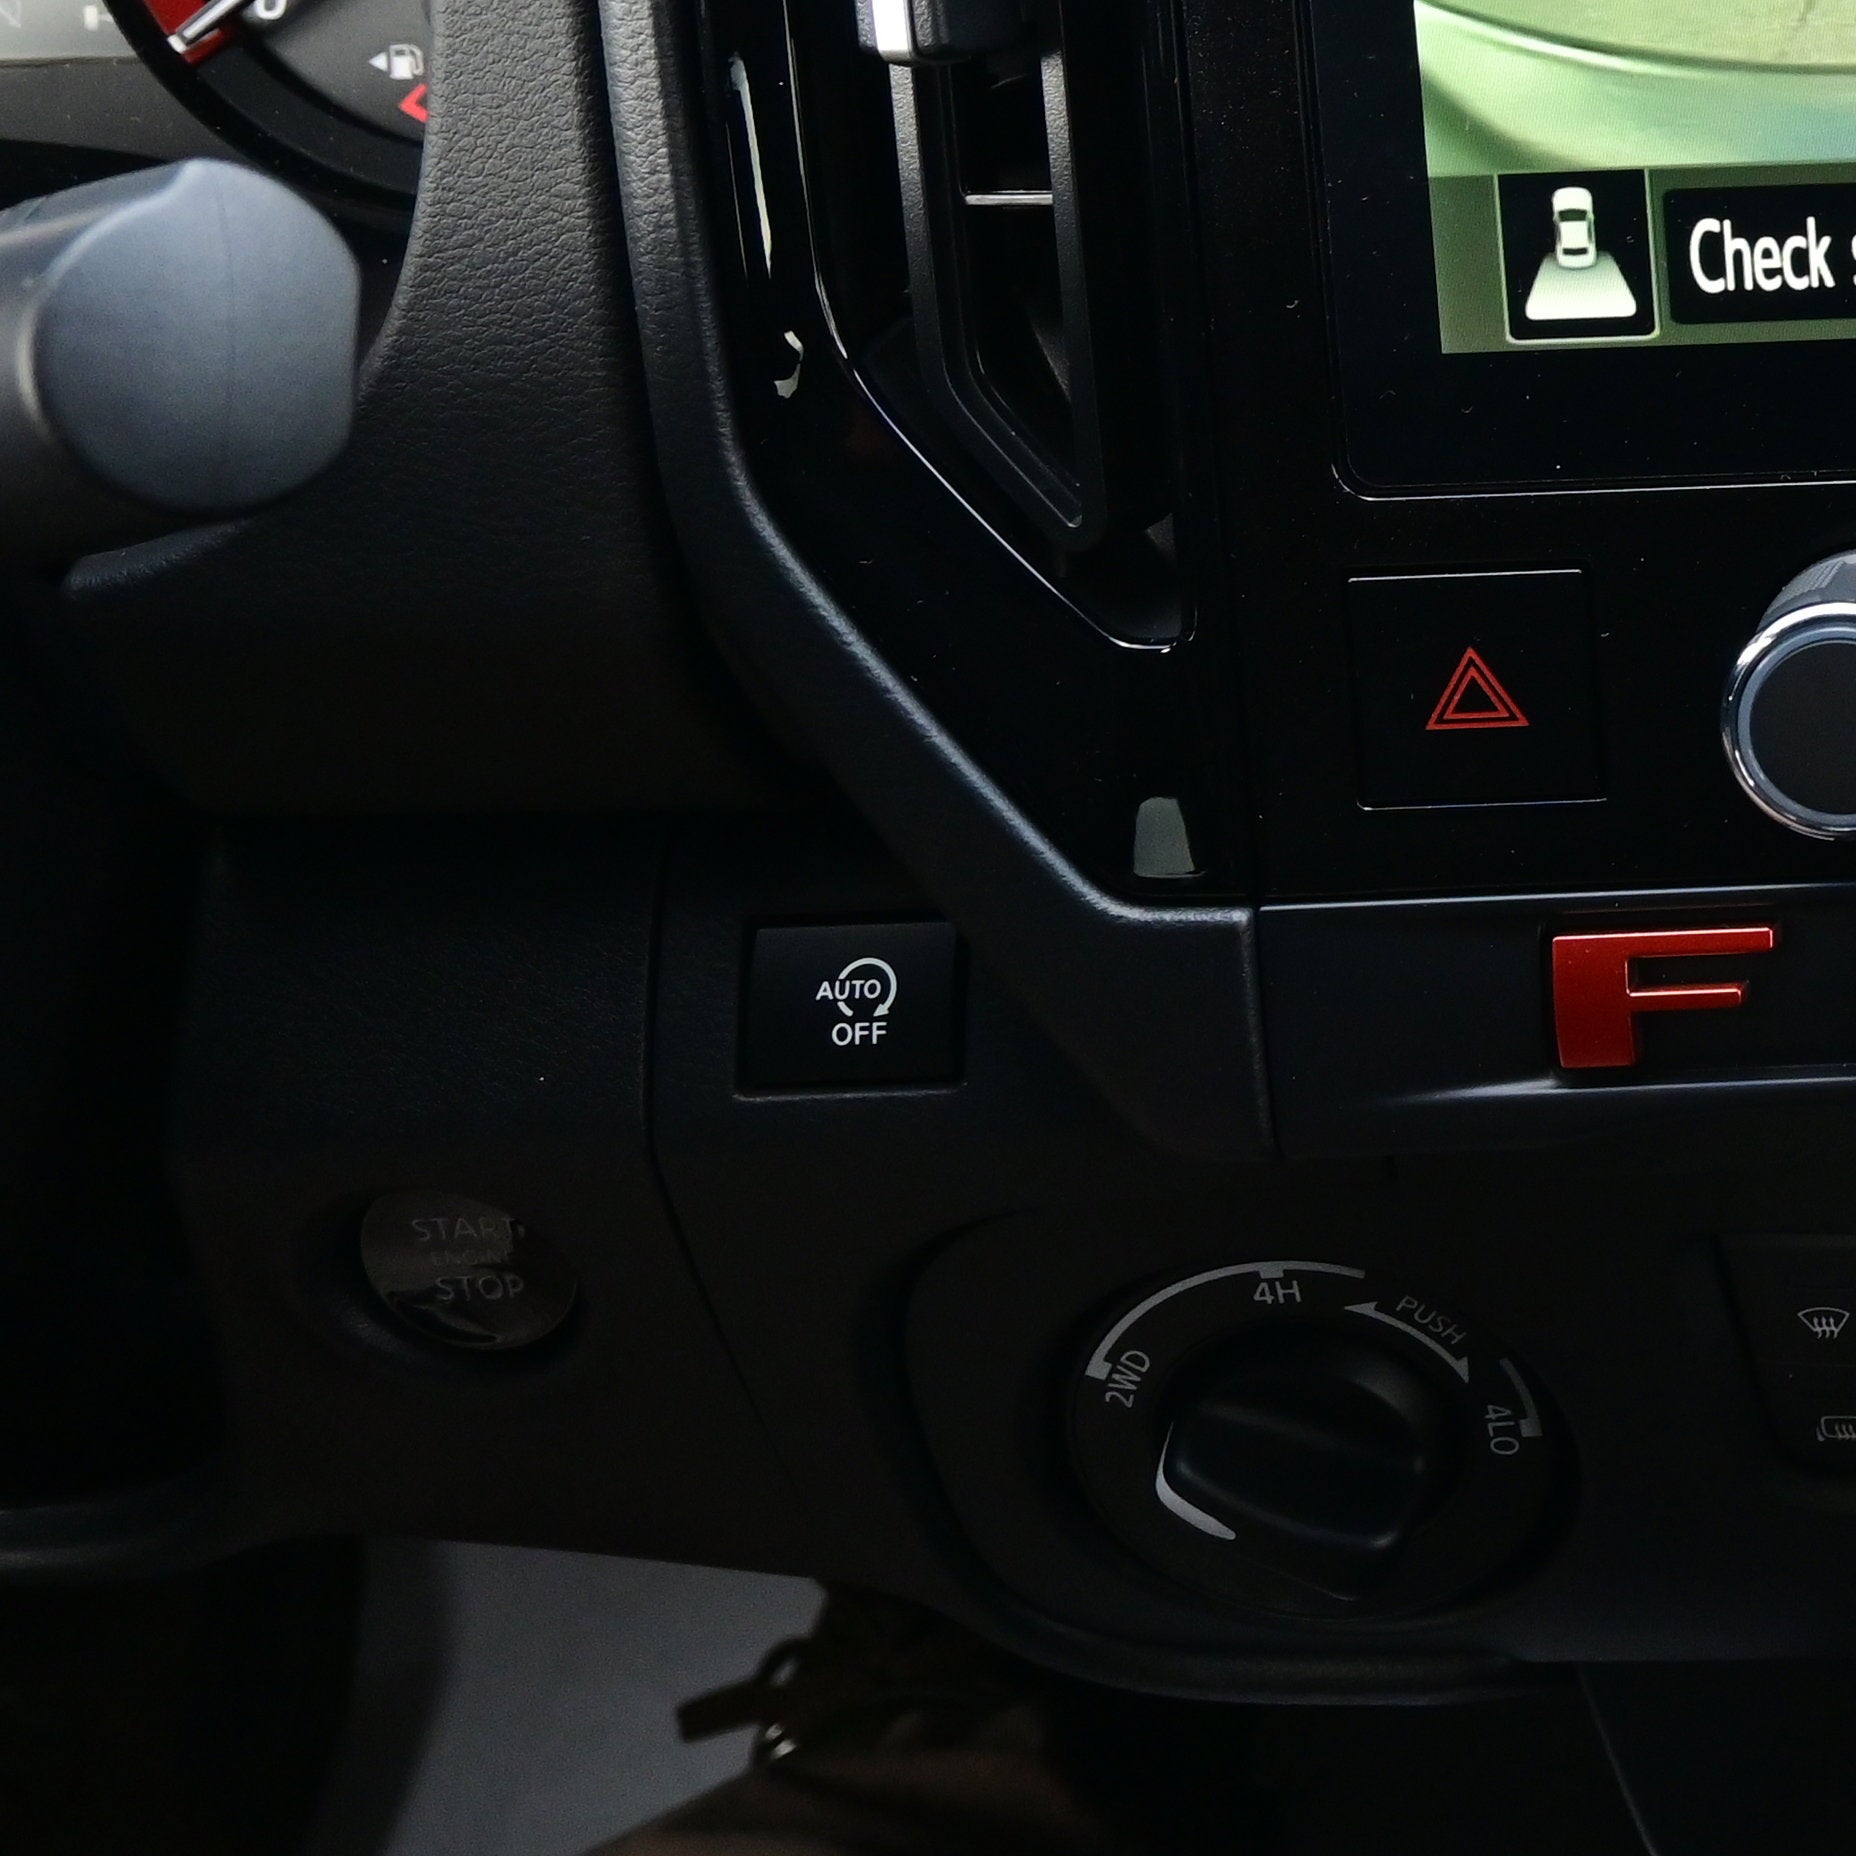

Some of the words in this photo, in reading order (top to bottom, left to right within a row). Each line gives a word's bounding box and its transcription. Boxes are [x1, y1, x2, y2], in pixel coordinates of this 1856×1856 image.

[1688, 213, 1832, 294] Check
[815, 978, 882, 1001] AUTO
[831, 1021, 887, 1046] OFF
[411, 1217, 516, 1242] START
[435, 1273, 525, 1302] STOP
[1252, 1280, 1302, 1305] 4H
[1395, 1295, 1467, 1346] PUSH
[1104, 1348, 1152, 1409] 2WD
[1484, 1403, 1520, 1456] 4LO
